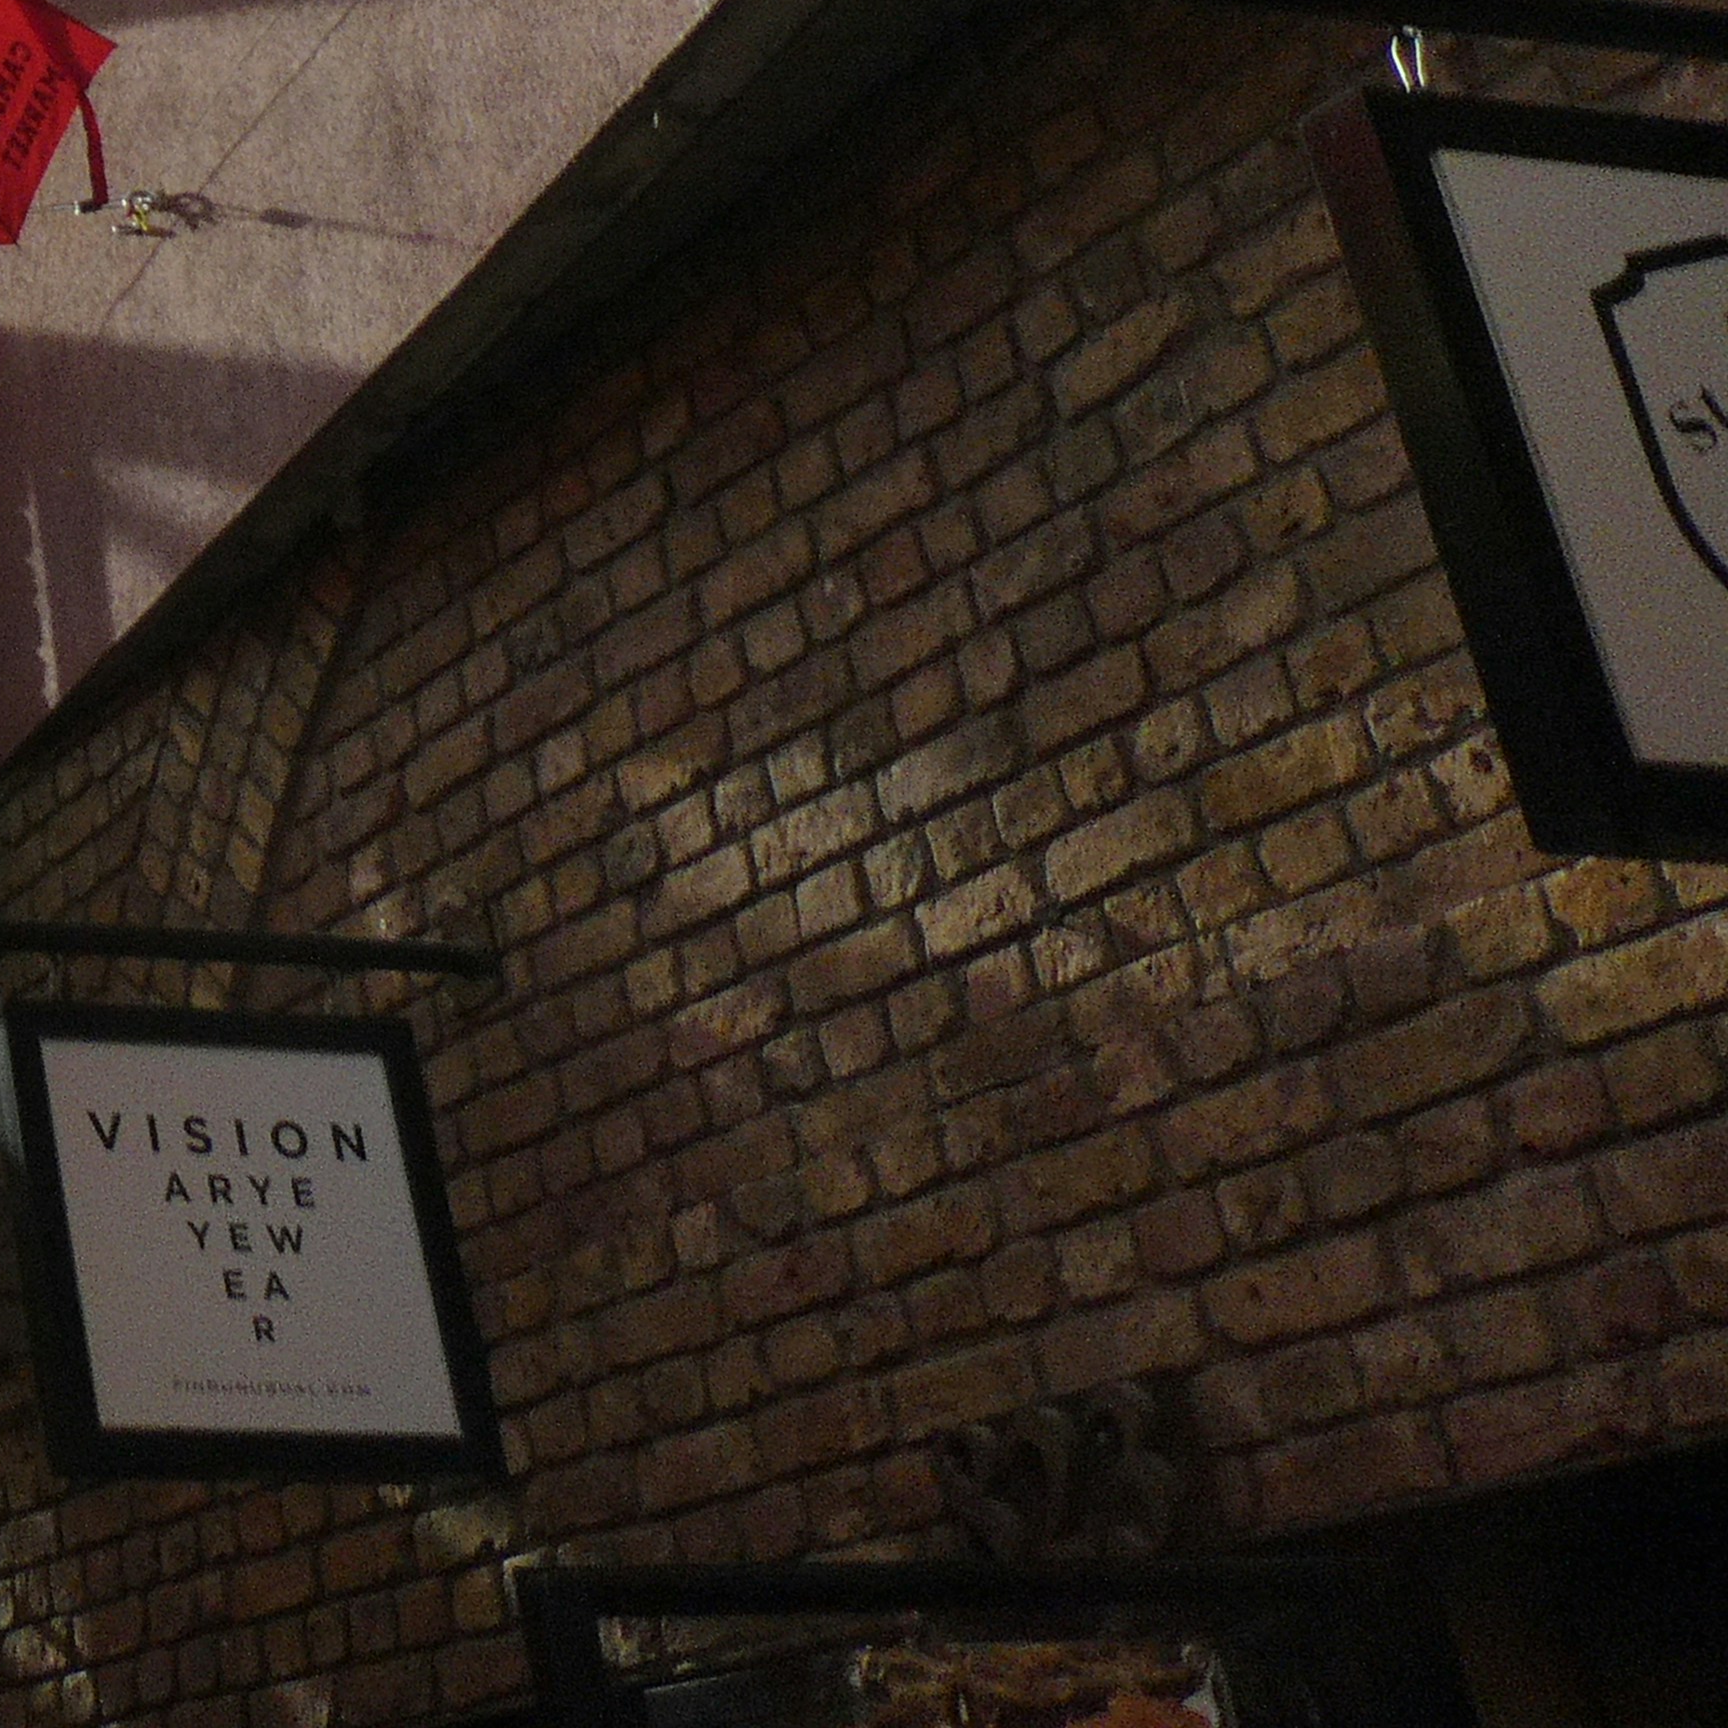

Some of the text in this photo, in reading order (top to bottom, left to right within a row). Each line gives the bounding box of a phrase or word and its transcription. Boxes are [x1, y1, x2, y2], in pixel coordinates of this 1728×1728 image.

[87, 1109, 369, 1163] VISION
[164, 1172, 316, 1209] ARYE
[187, 1220, 305, 1255] YEW
[222, 1270, 291, 1302] EA
[252, 1314, 276, 1343] R
